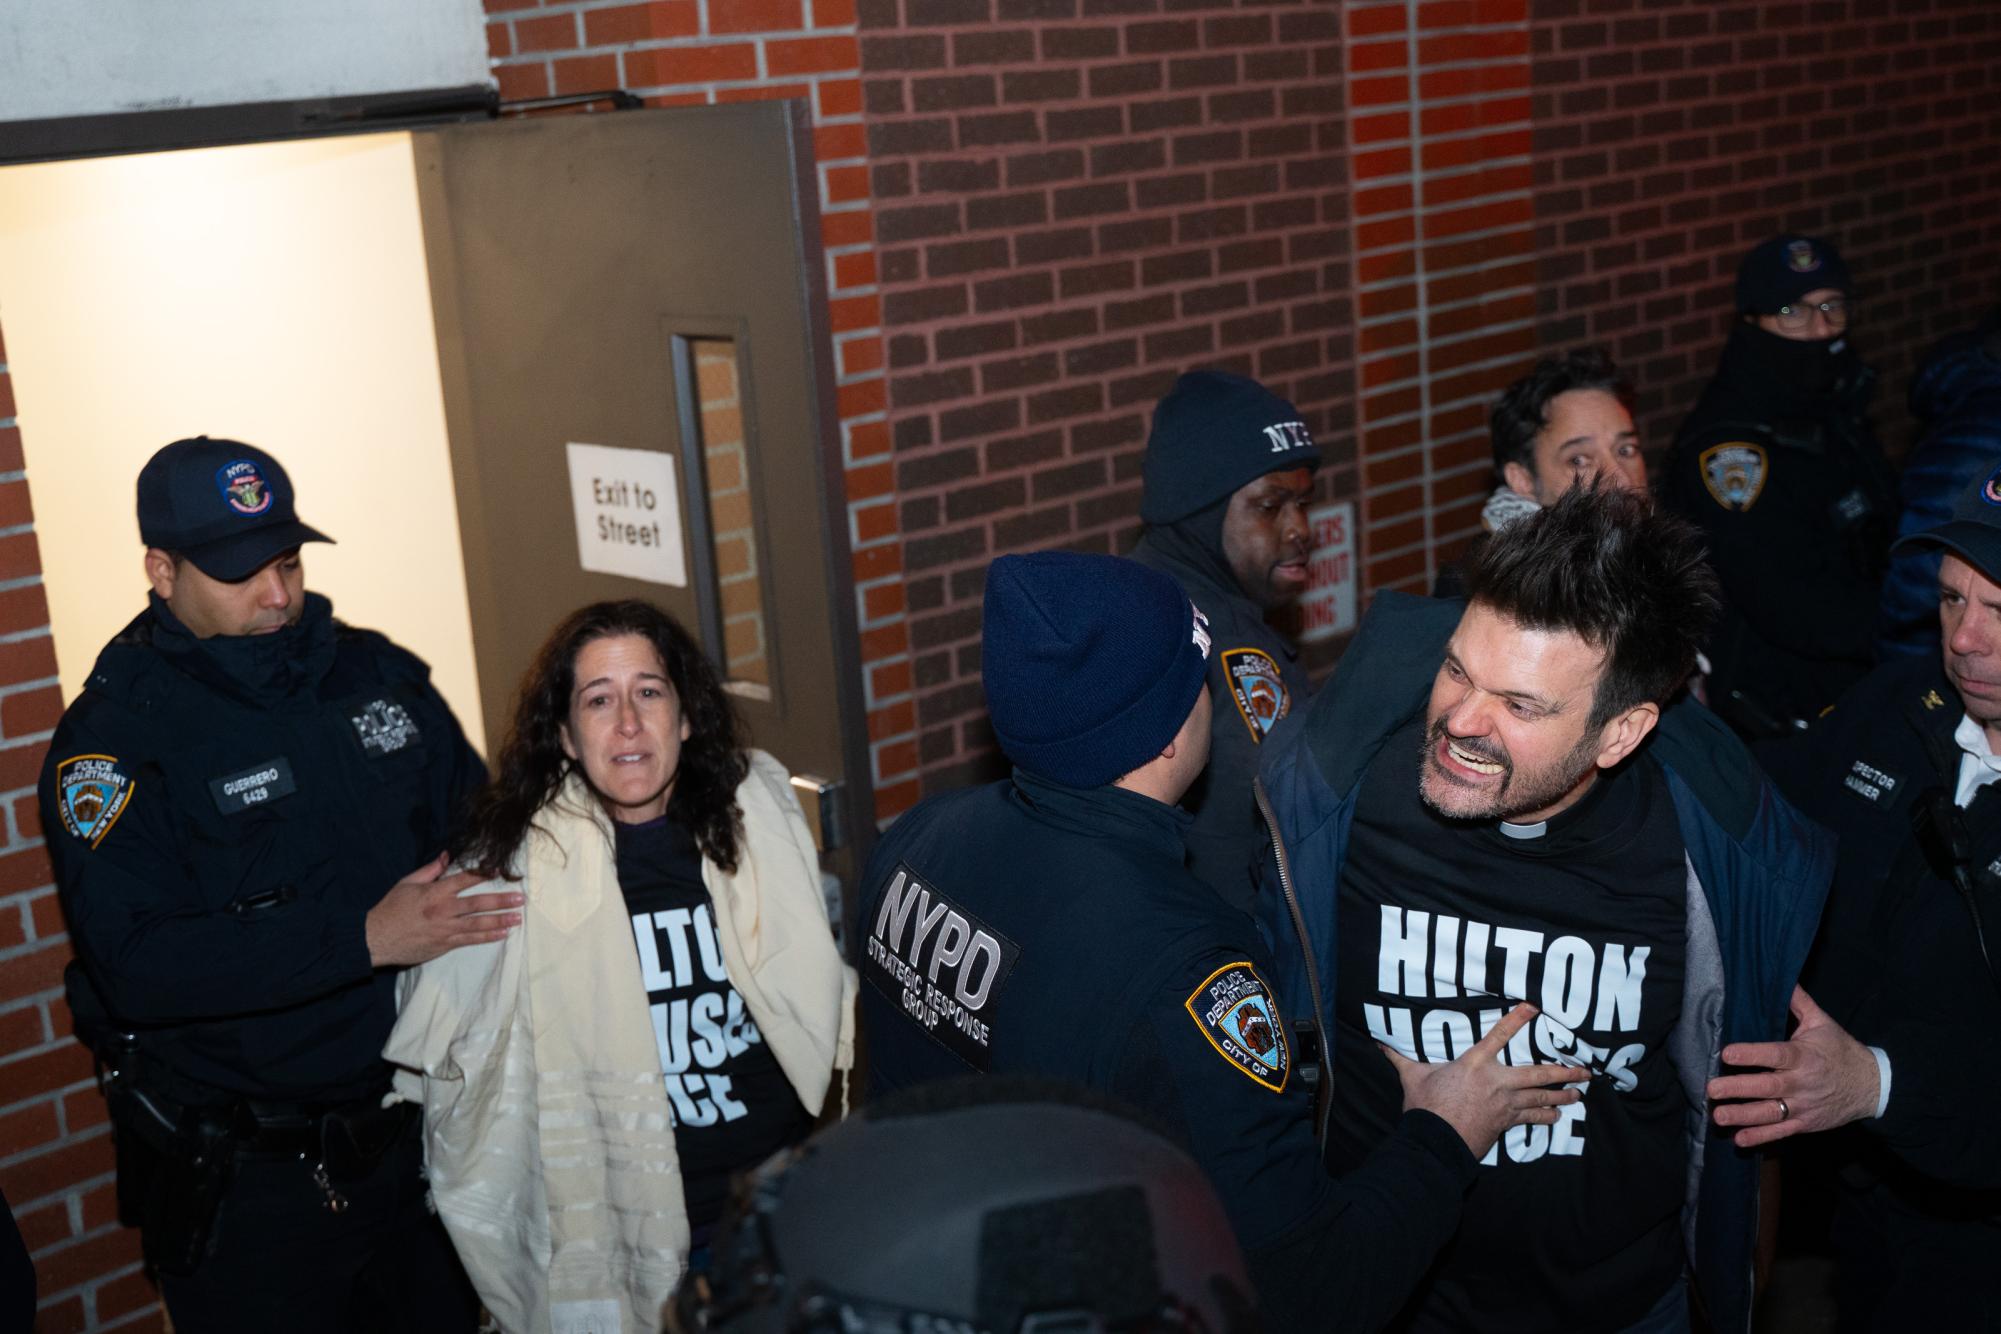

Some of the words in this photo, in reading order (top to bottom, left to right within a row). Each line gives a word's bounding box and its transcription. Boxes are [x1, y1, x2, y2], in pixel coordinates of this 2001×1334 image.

[1263, 421, 1312, 452] NY
[593, 477, 629, 508] Exit
[633, 483, 656, 511] to
[598, 515, 661, 548] Street
[62, 770, 127, 788] DEPARTMENT
[74, 760, 114, 772] POLICE
[223, 768, 279, 796] GUERRERO
[632, 903, 729, 993] LTO
[875, 871, 1001, 1011] NYPD
[1209, 970, 1247, 1001] POLICE
[1378, 904, 1651, 1033] HILTON
[868, 935, 923, 996] STRATEGIC
[924, 983, 990, 1047] RESPONSE
[901, 988, 939, 1030] GROUP
[1222, 1039, 1250, 1065] CITY
[1252, 1061, 1269, 1077] OF
